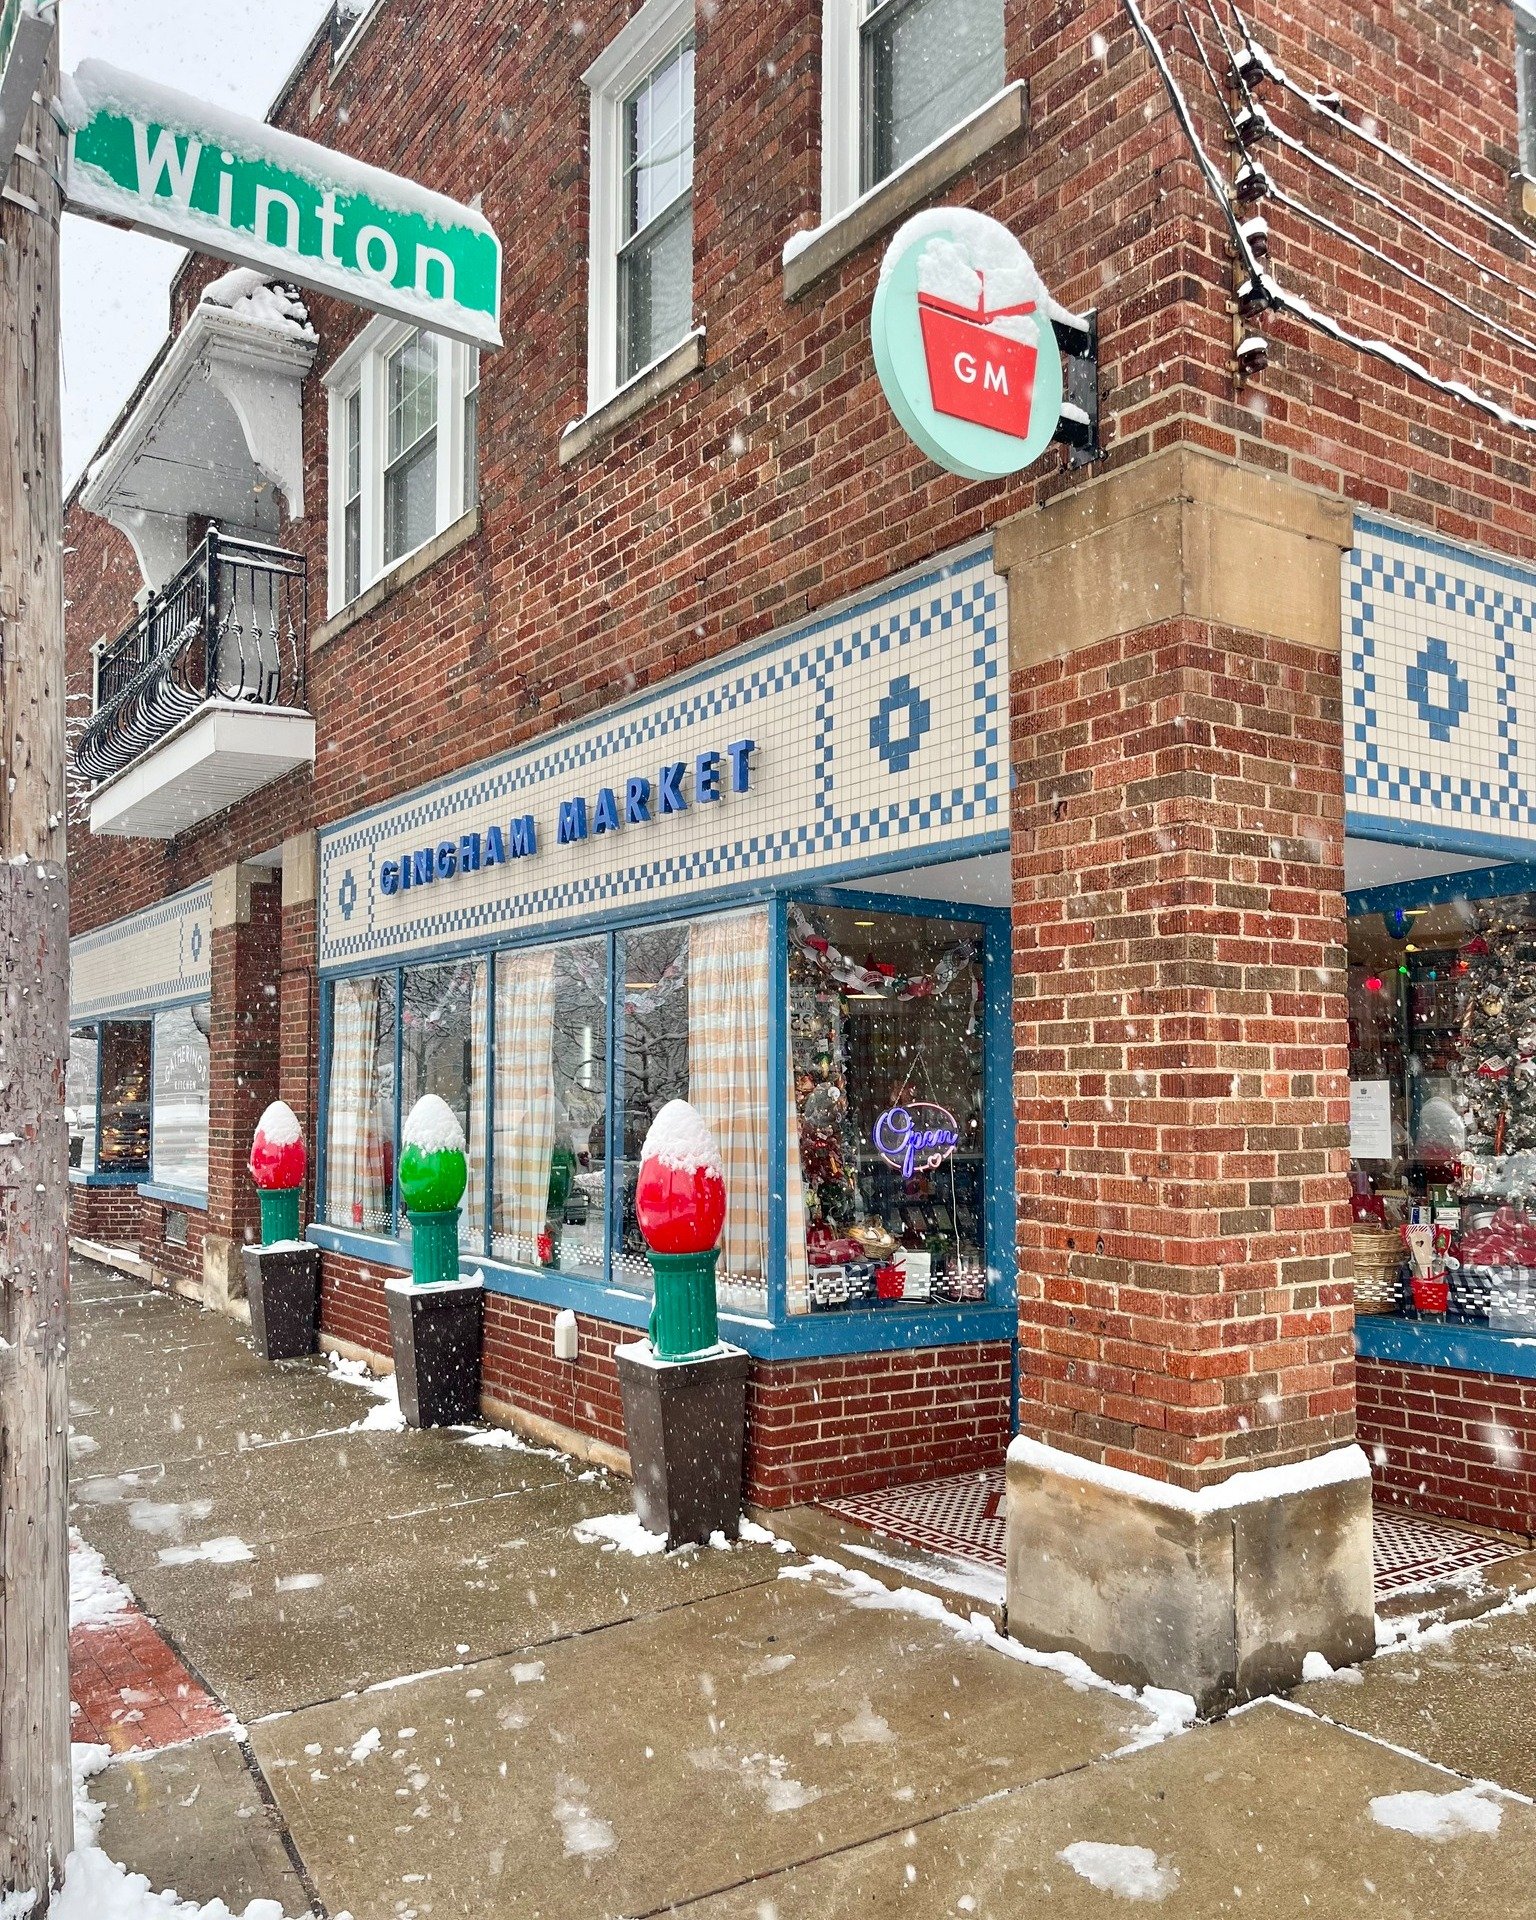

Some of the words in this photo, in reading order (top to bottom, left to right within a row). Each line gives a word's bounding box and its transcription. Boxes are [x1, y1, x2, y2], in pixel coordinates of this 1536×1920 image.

[133, 123, 455, 300] Winton
[953, 351, 1009, 396] GM
[380, 814, 538, 895] GINGHAM
[557, 739, 755, 844] MARKET
[163, 1045, 207, 1085] GATHERINGS
[174, 1080, 197, 1090] KITCHEN
[873, 1107, 959, 1179] Open
